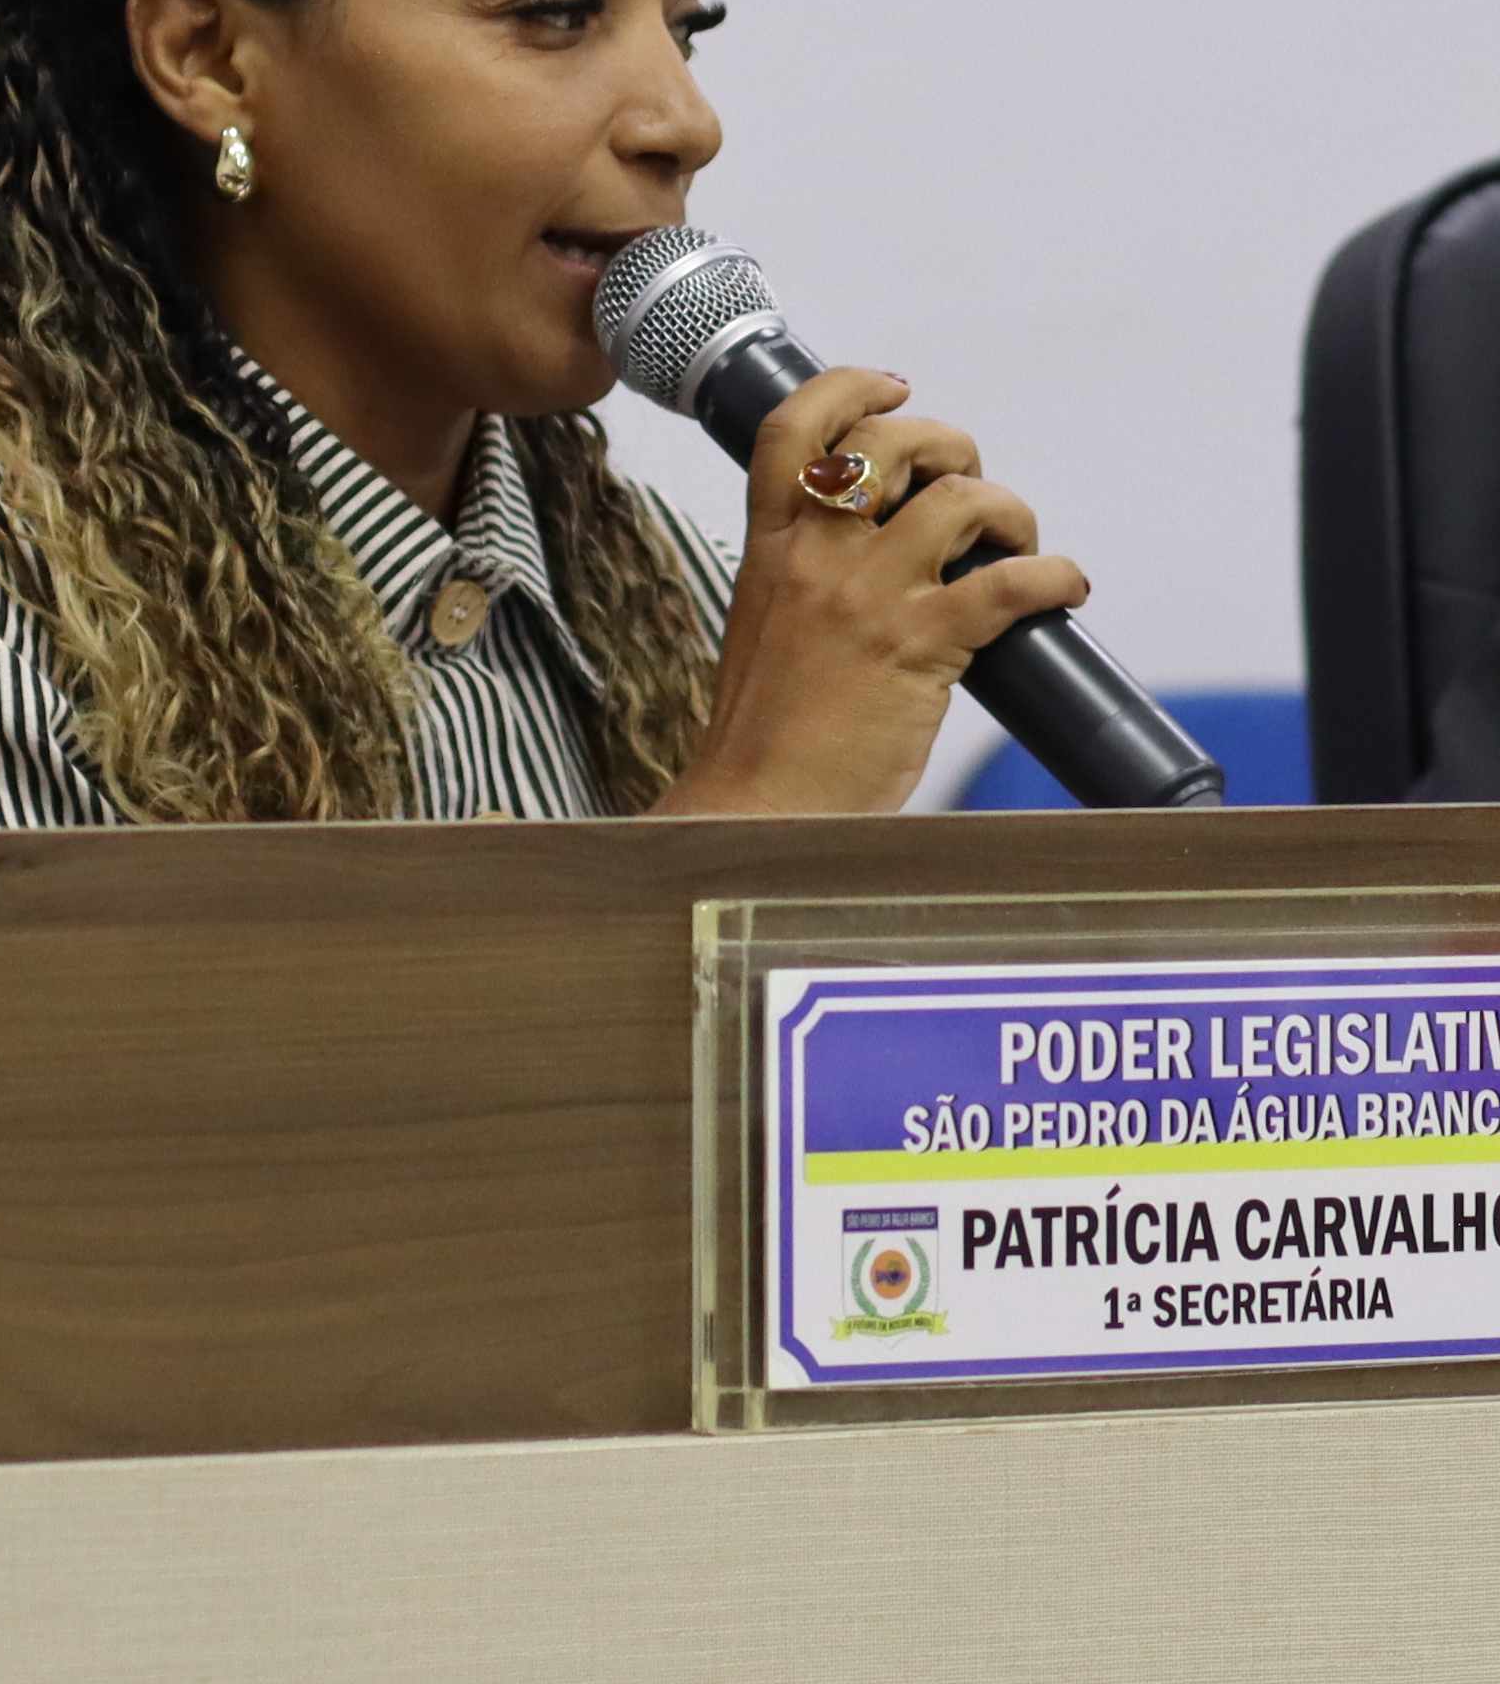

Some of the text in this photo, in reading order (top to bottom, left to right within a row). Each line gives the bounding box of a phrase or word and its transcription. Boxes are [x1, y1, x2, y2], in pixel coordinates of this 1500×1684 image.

[1000, 1018, 1195, 1085] PODER
[902, 1093, 992, 1154] SÃO
[1003, 1098, 1149, 1151] PEDRO
[1160, 1096, 1220, 1146] DA
[1225, 1080, 1347, 1144] ÁGUA
[962, 1183, 1220, 1271] PATRÍCIA
[1152, 1265, 1394, 1329] SECRETÁRIA
